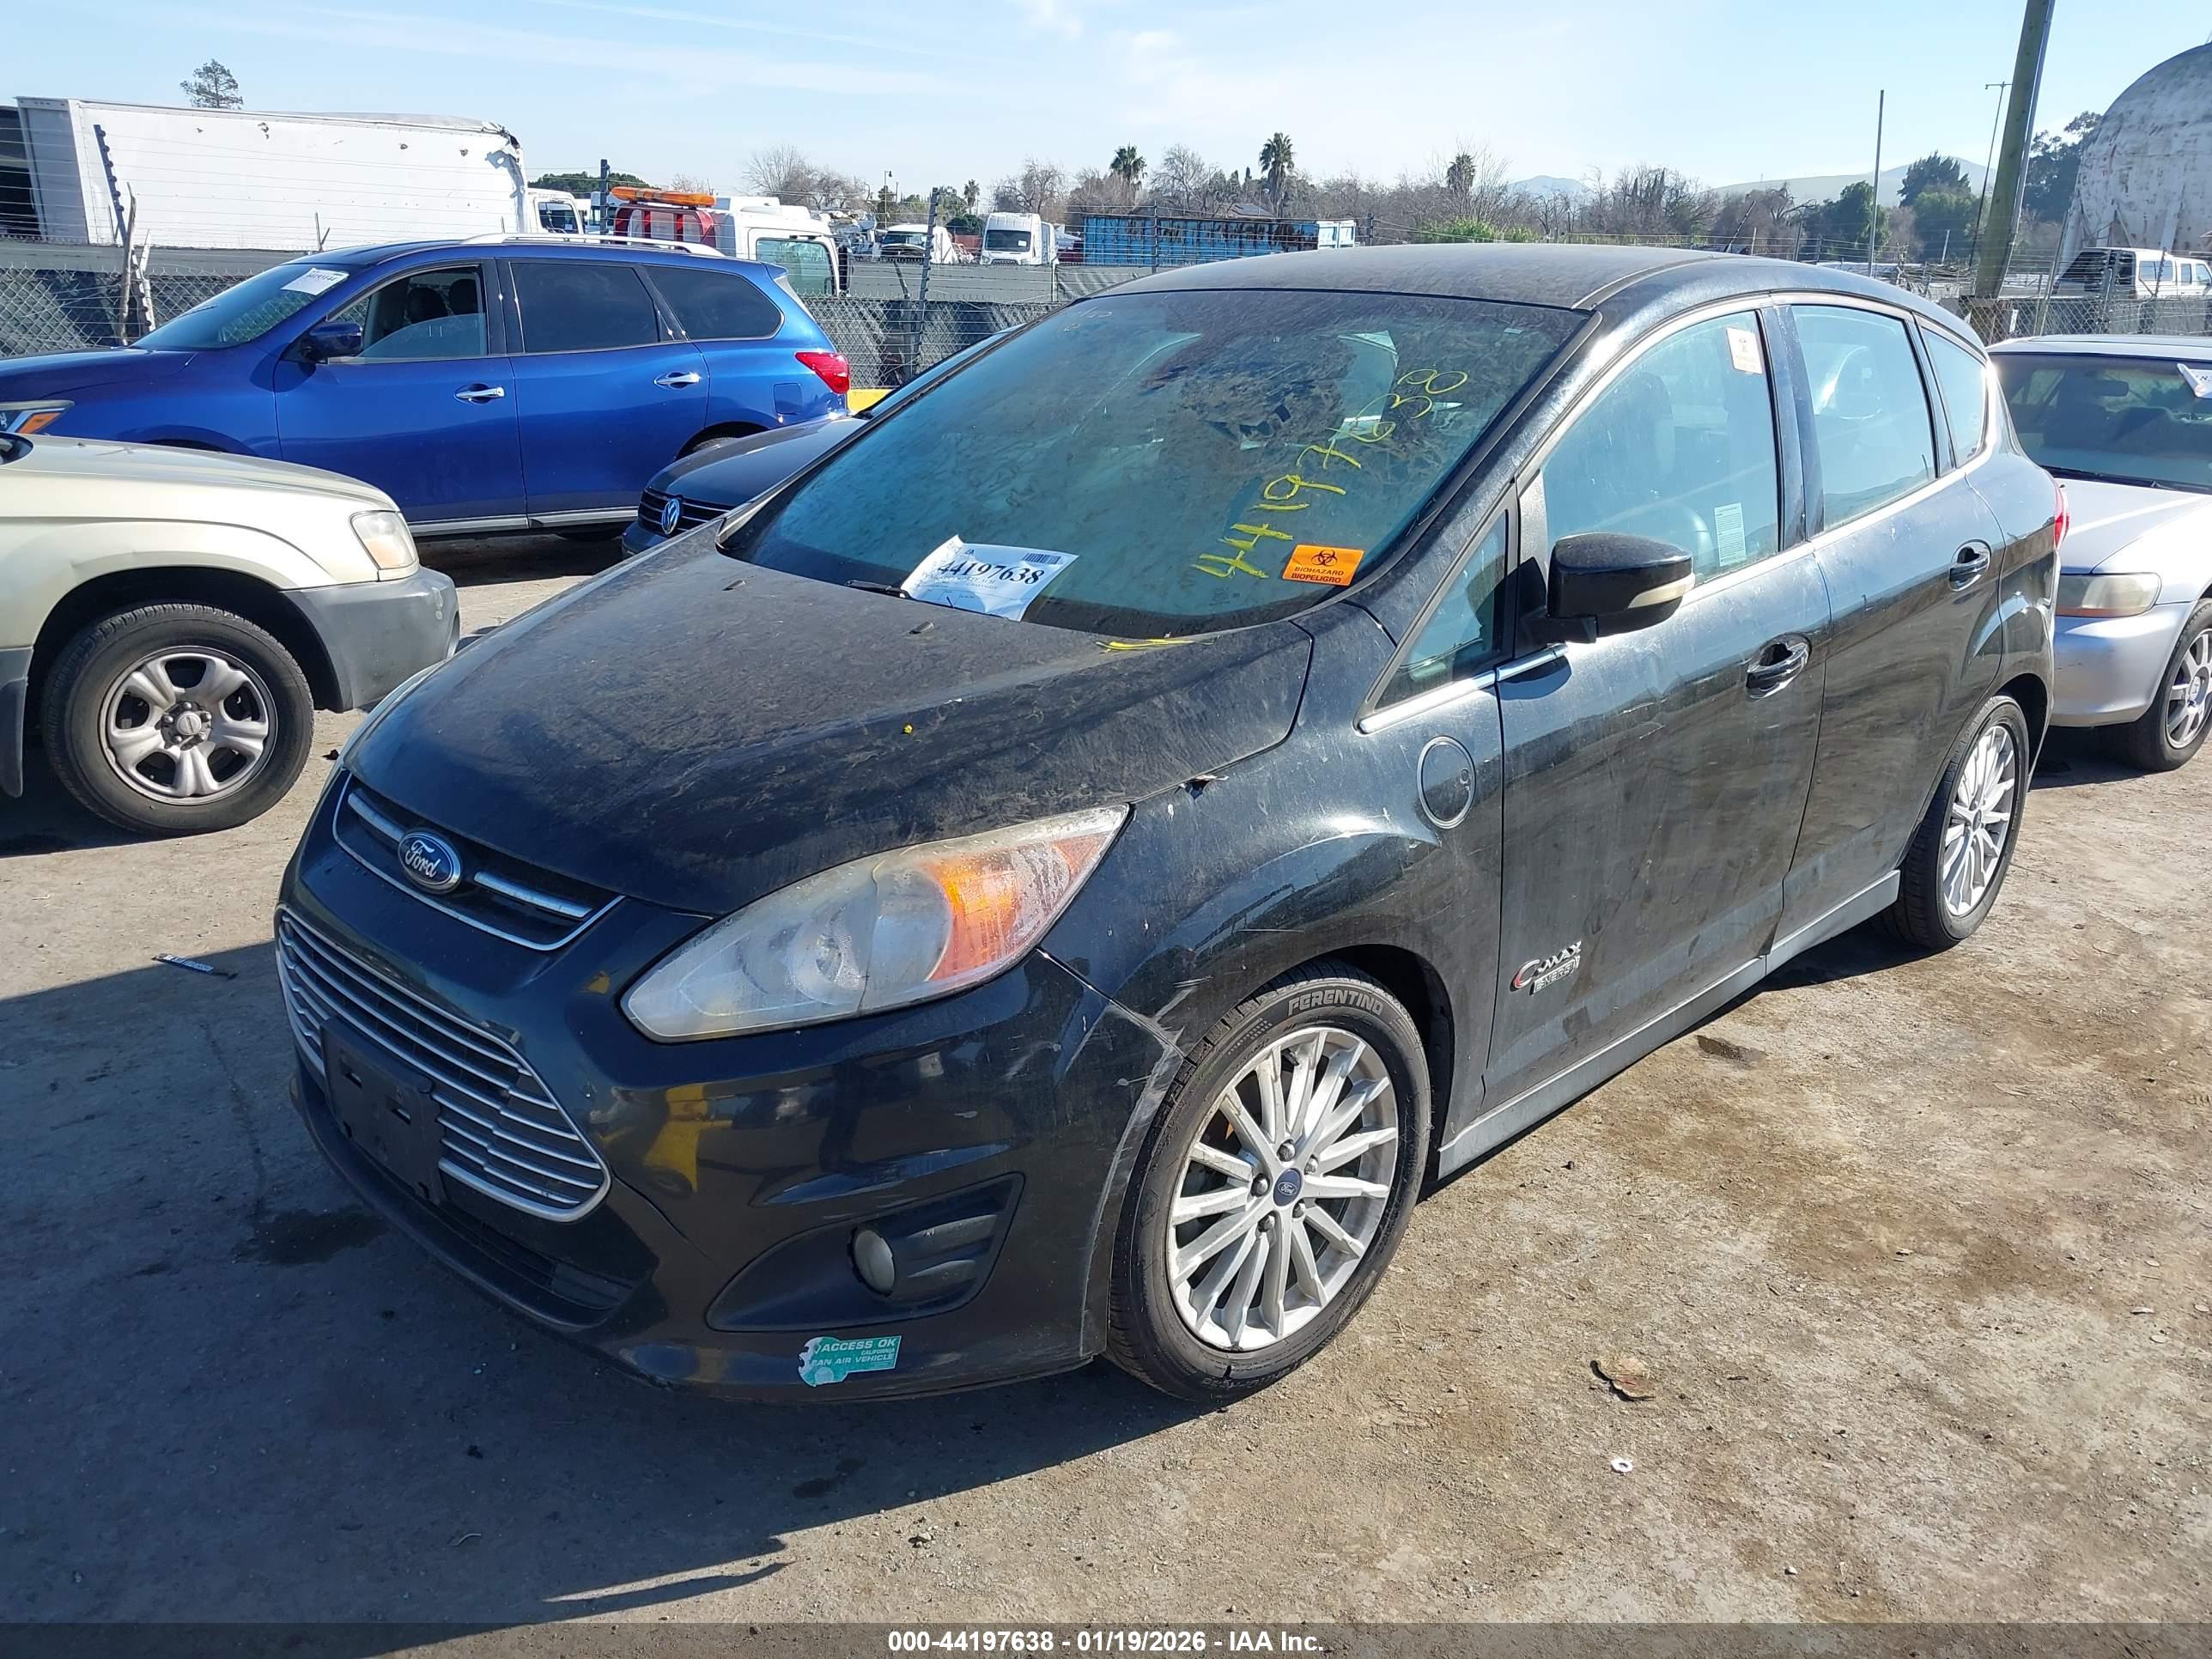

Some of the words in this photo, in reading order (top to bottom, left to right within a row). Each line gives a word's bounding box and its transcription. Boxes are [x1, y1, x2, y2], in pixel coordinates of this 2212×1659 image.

[1190, 368, 1468, 580] 44197638
[937, 559, 1046, 585] 44197638
[1291, 573, 1342, 583] BIOPELIGRO
[1294, 566, 1345, 576] BIOHAZARD
[404, 840, 442, 878] Ford
[1287, 988, 1385, 1017] FERENTINO
[820, 1340, 873, 1352] ACCESS
[878, 1338, 897, 1347] OK
[855, 1353, 895, 1363] VEHICLE
